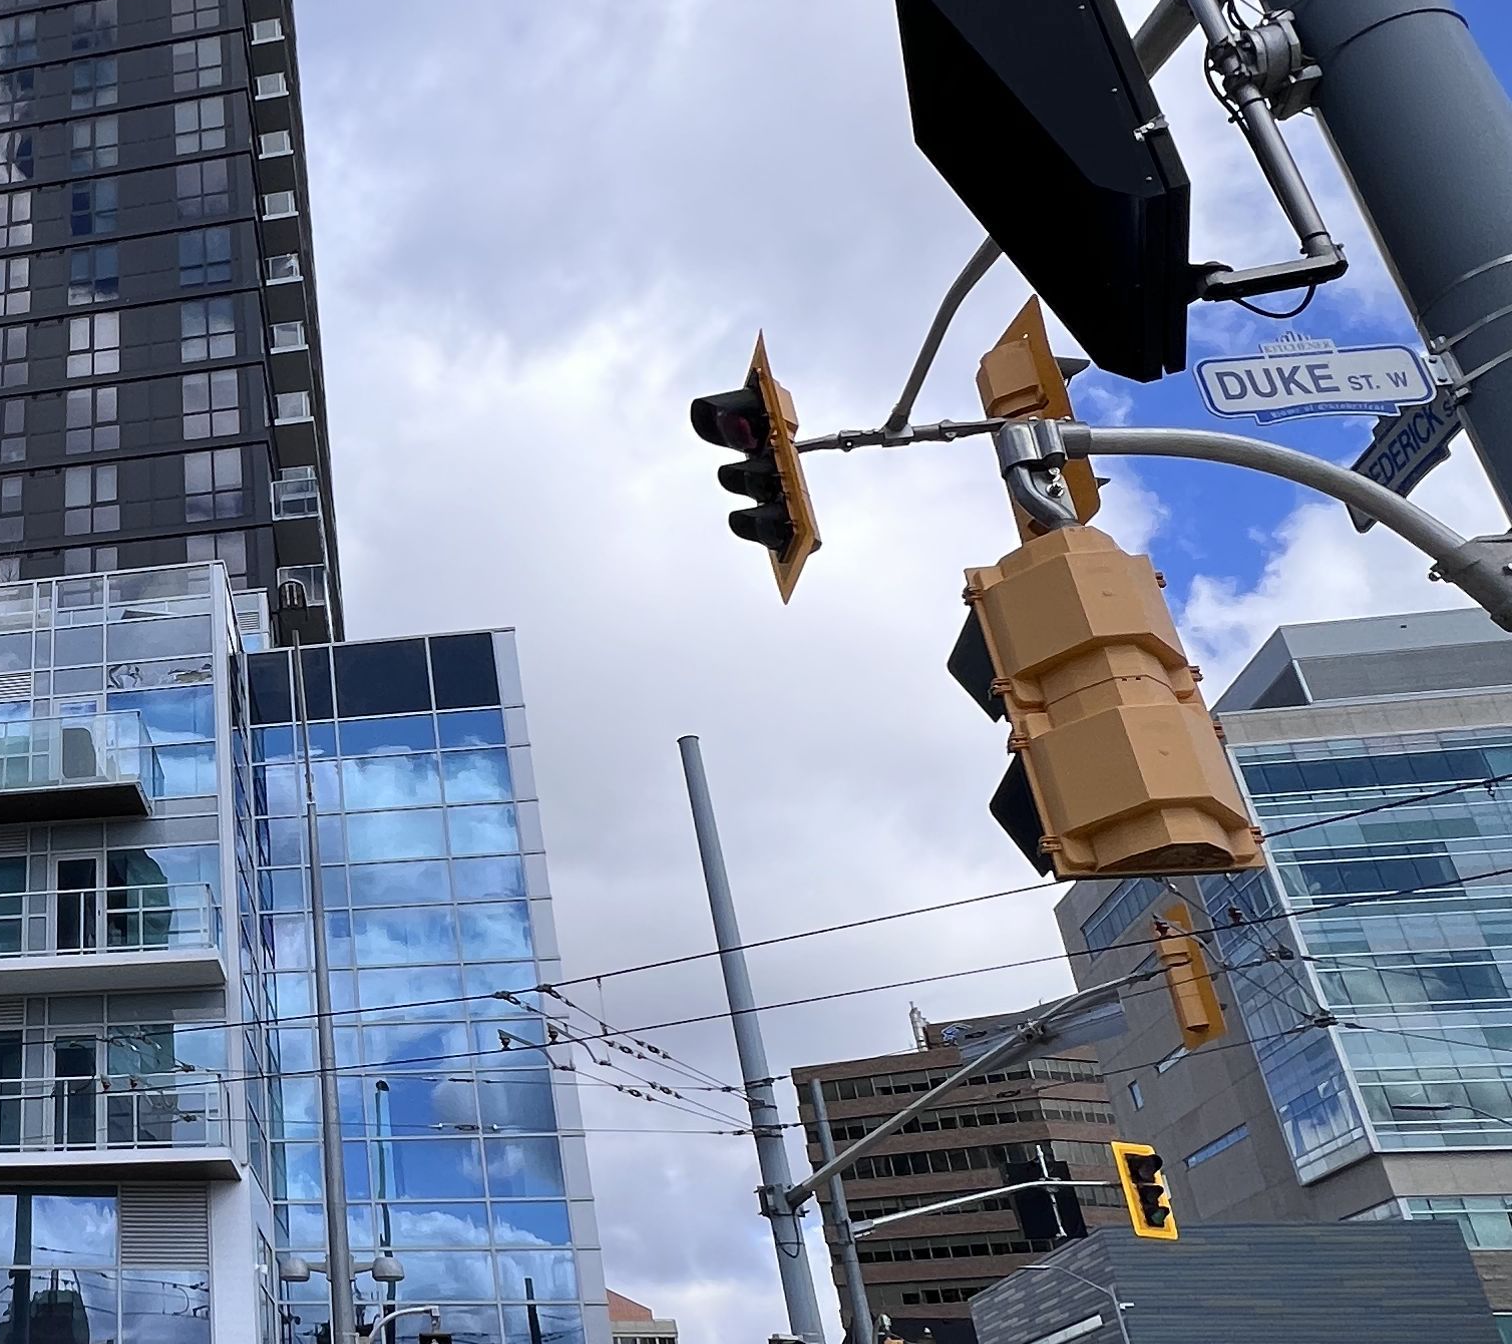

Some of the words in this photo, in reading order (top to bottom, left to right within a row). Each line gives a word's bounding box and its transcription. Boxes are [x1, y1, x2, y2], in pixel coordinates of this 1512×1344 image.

[1264, 341, 1330, 354] KITCHENER
[1215, 363, 1341, 401] DUKE
[1347, 374, 1380, 391] ST.
[1386, 371, 1408, 388] W
[1368, 404, 1444, 486] EDERICK
